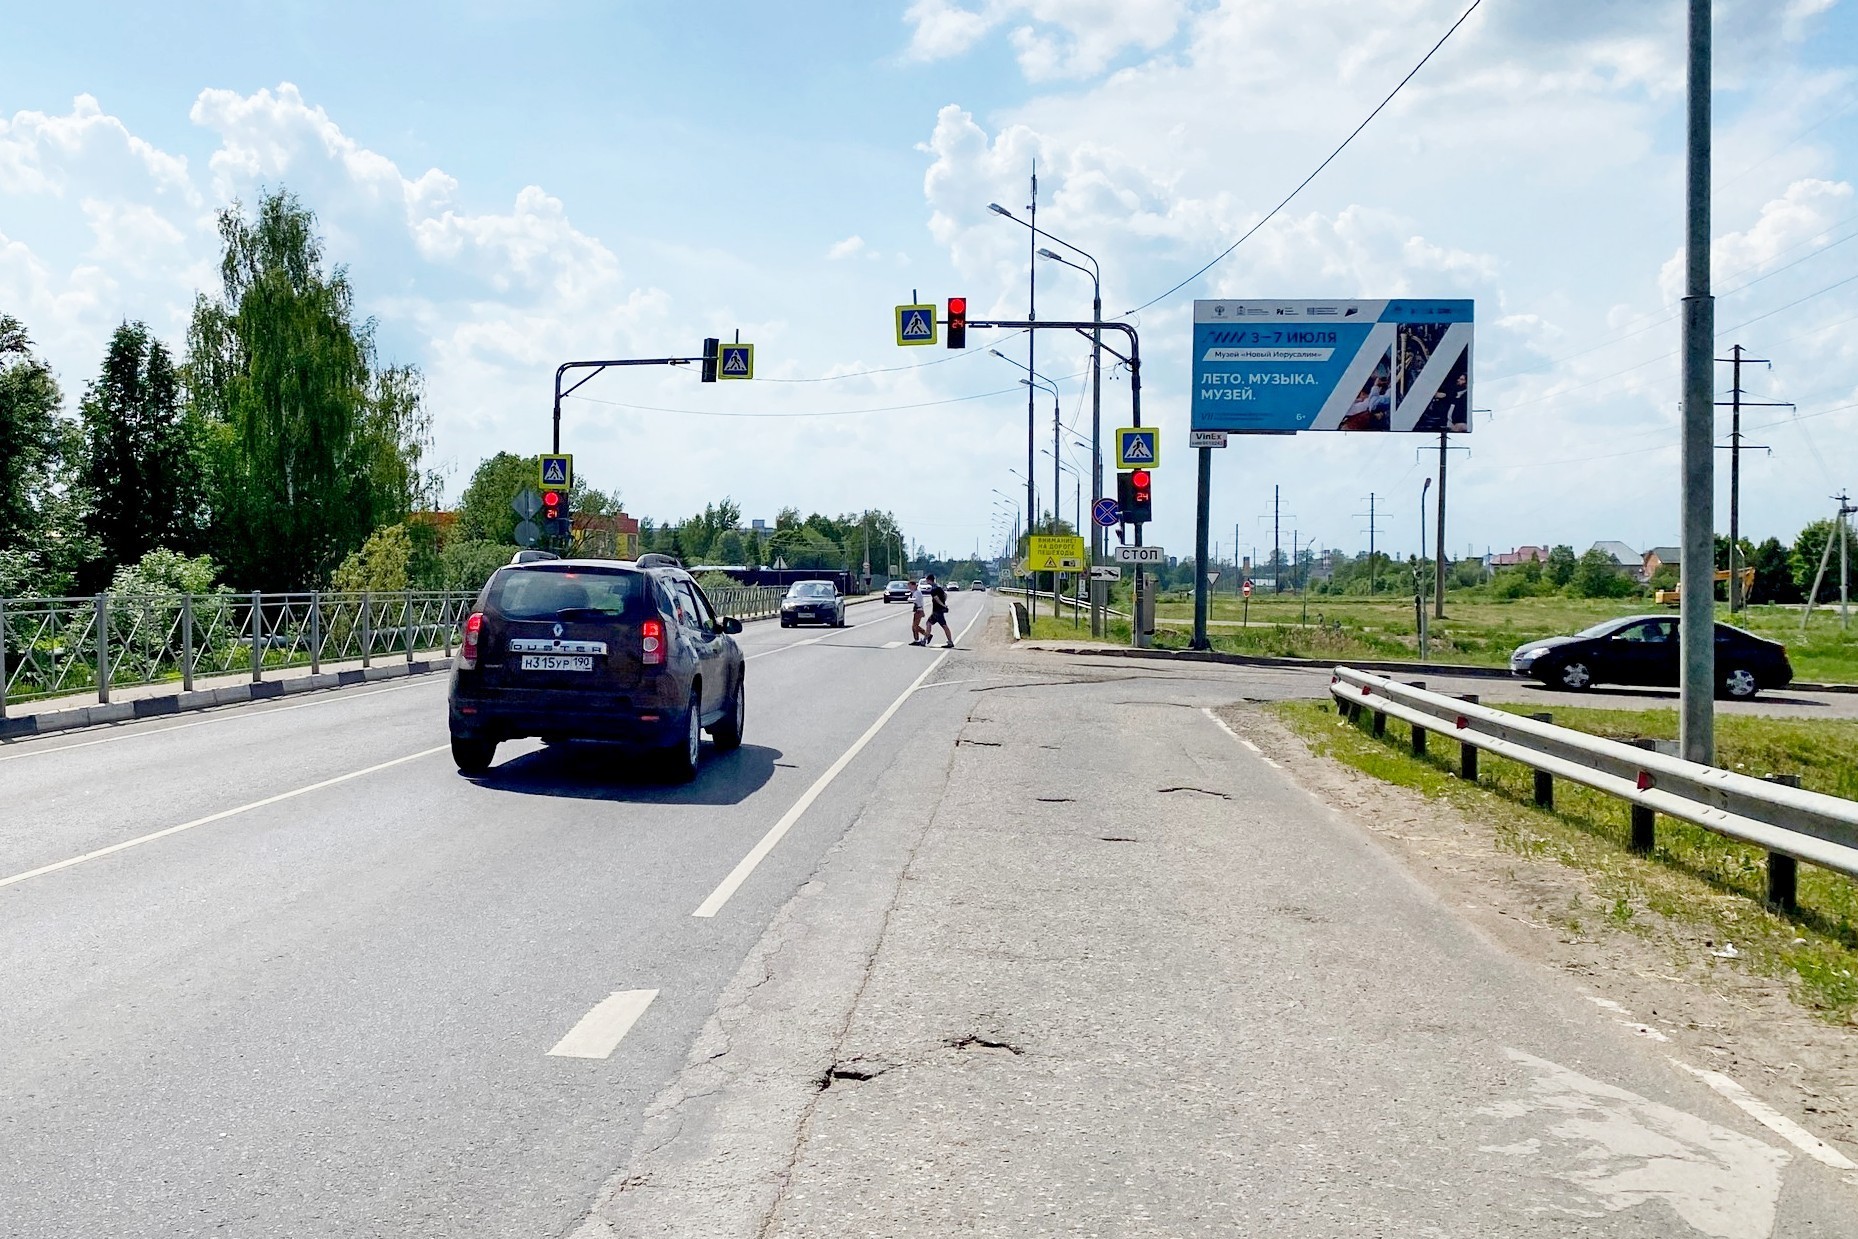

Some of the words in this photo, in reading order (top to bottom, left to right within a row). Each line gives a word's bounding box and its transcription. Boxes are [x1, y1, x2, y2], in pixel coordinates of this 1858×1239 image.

[952, 319, 963, 328] 24
[1287, 332, 1337, 343] ИЮЛЯ
[1215, 350, 1240, 359] Музей
[1241, 350, 1272, 358] «Новый
[1273, 351, 1322, 359] Иерусалим»
[1201, 373, 1245, 385] ЛЕТО.
[1248, 373, 1319, 385] МУЗЫКА.
[1201, 387, 1256, 400] МУЗЕЙ.
[1136, 492, 1149, 502] 24
[547, 509, 557, 518] 24
[1122, 549, 1158, 560] СТОП
[513, 644, 602, 653] DUSTER
[573, 657, 590, 667] 190
